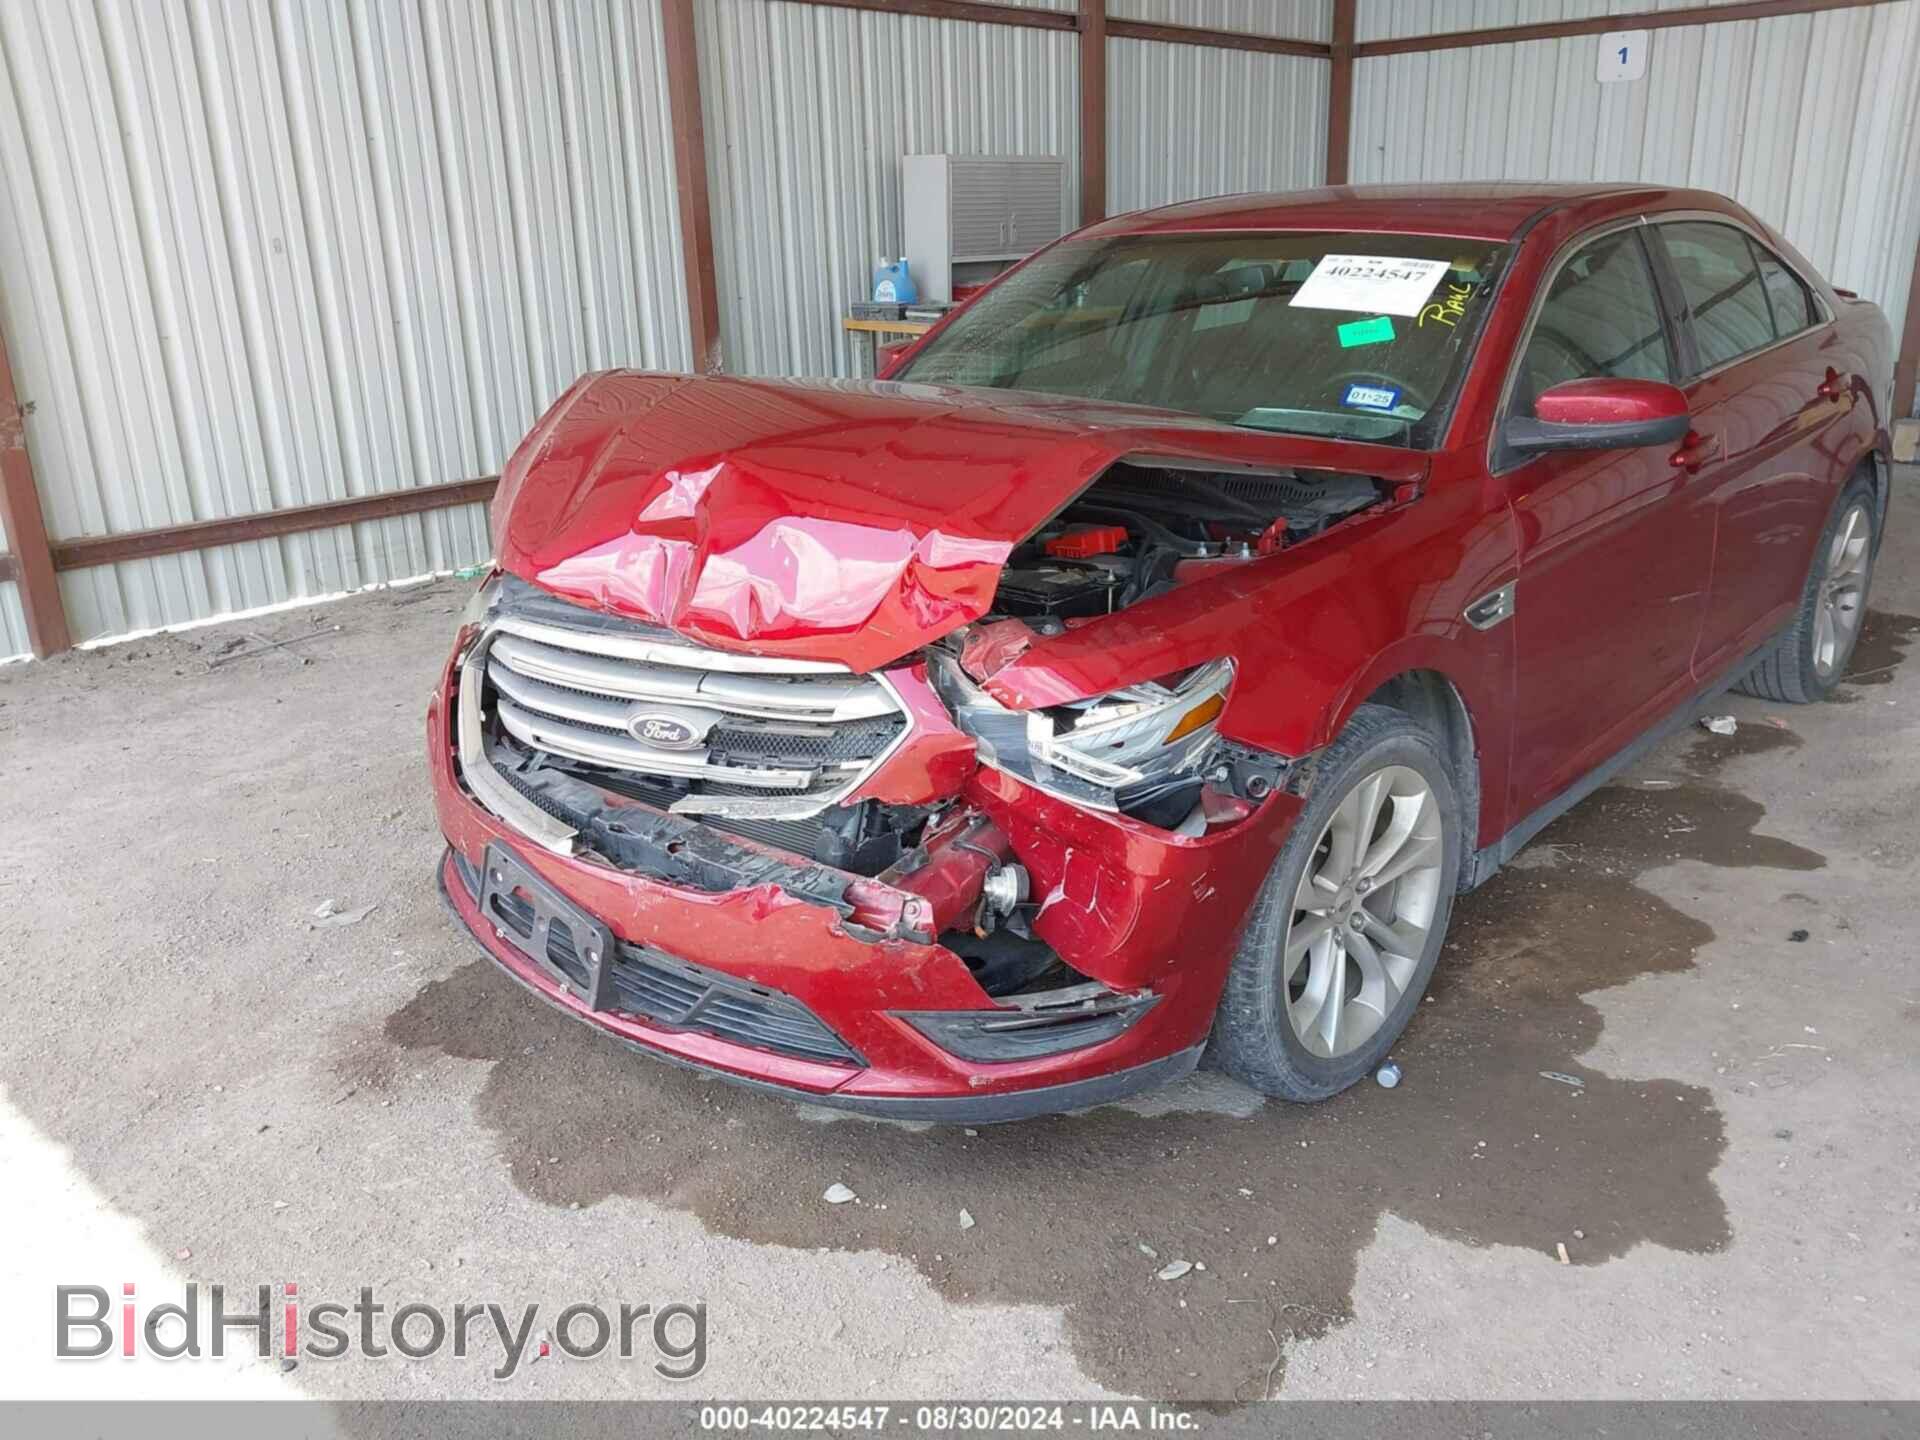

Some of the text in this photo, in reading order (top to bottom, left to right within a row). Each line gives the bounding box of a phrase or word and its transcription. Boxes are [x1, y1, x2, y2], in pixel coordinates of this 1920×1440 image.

[1618, 47, 1628, 65] 1
[1325, 266, 1427, 281] 40224547
[643, 720, 681, 741] Ford
